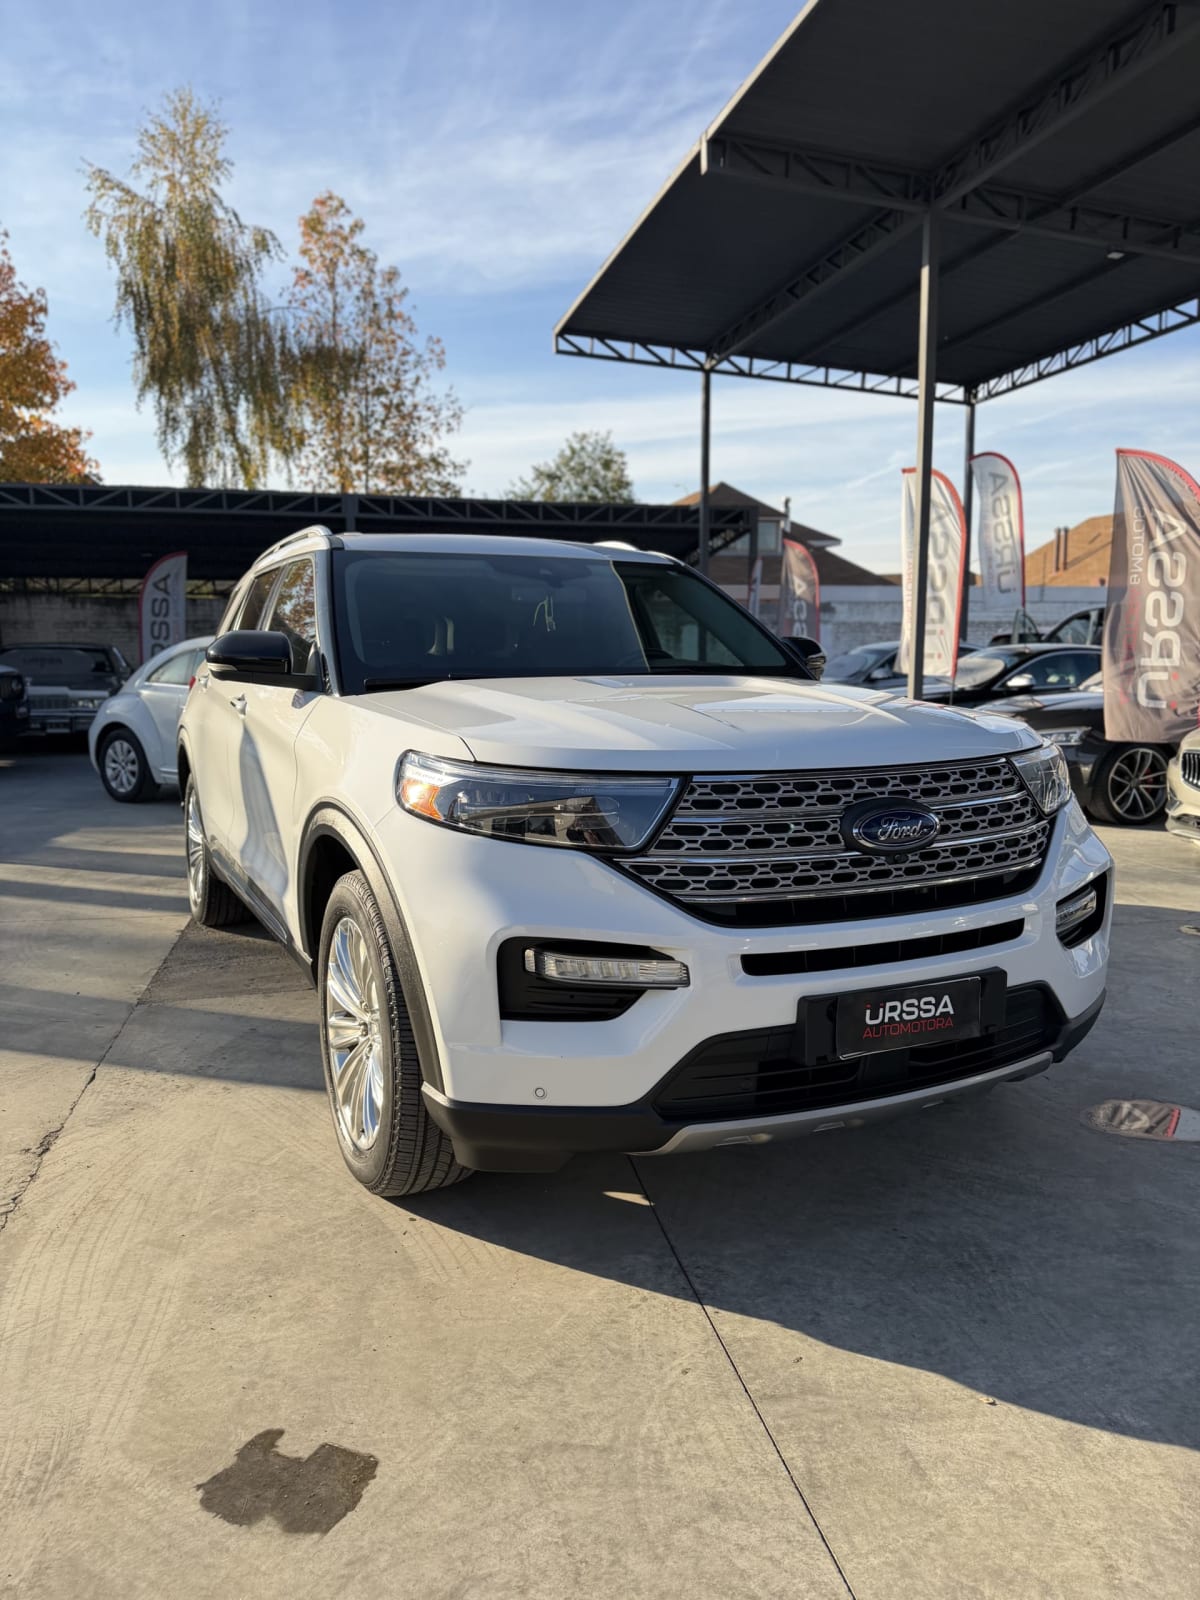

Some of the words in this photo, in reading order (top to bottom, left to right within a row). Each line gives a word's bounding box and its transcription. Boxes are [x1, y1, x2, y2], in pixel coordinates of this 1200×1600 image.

[151, 573, 171, 656] RSSA
[877, 816, 928, 840] Ford
[863, 1016, 954, 1039] AUTOMOTORA
